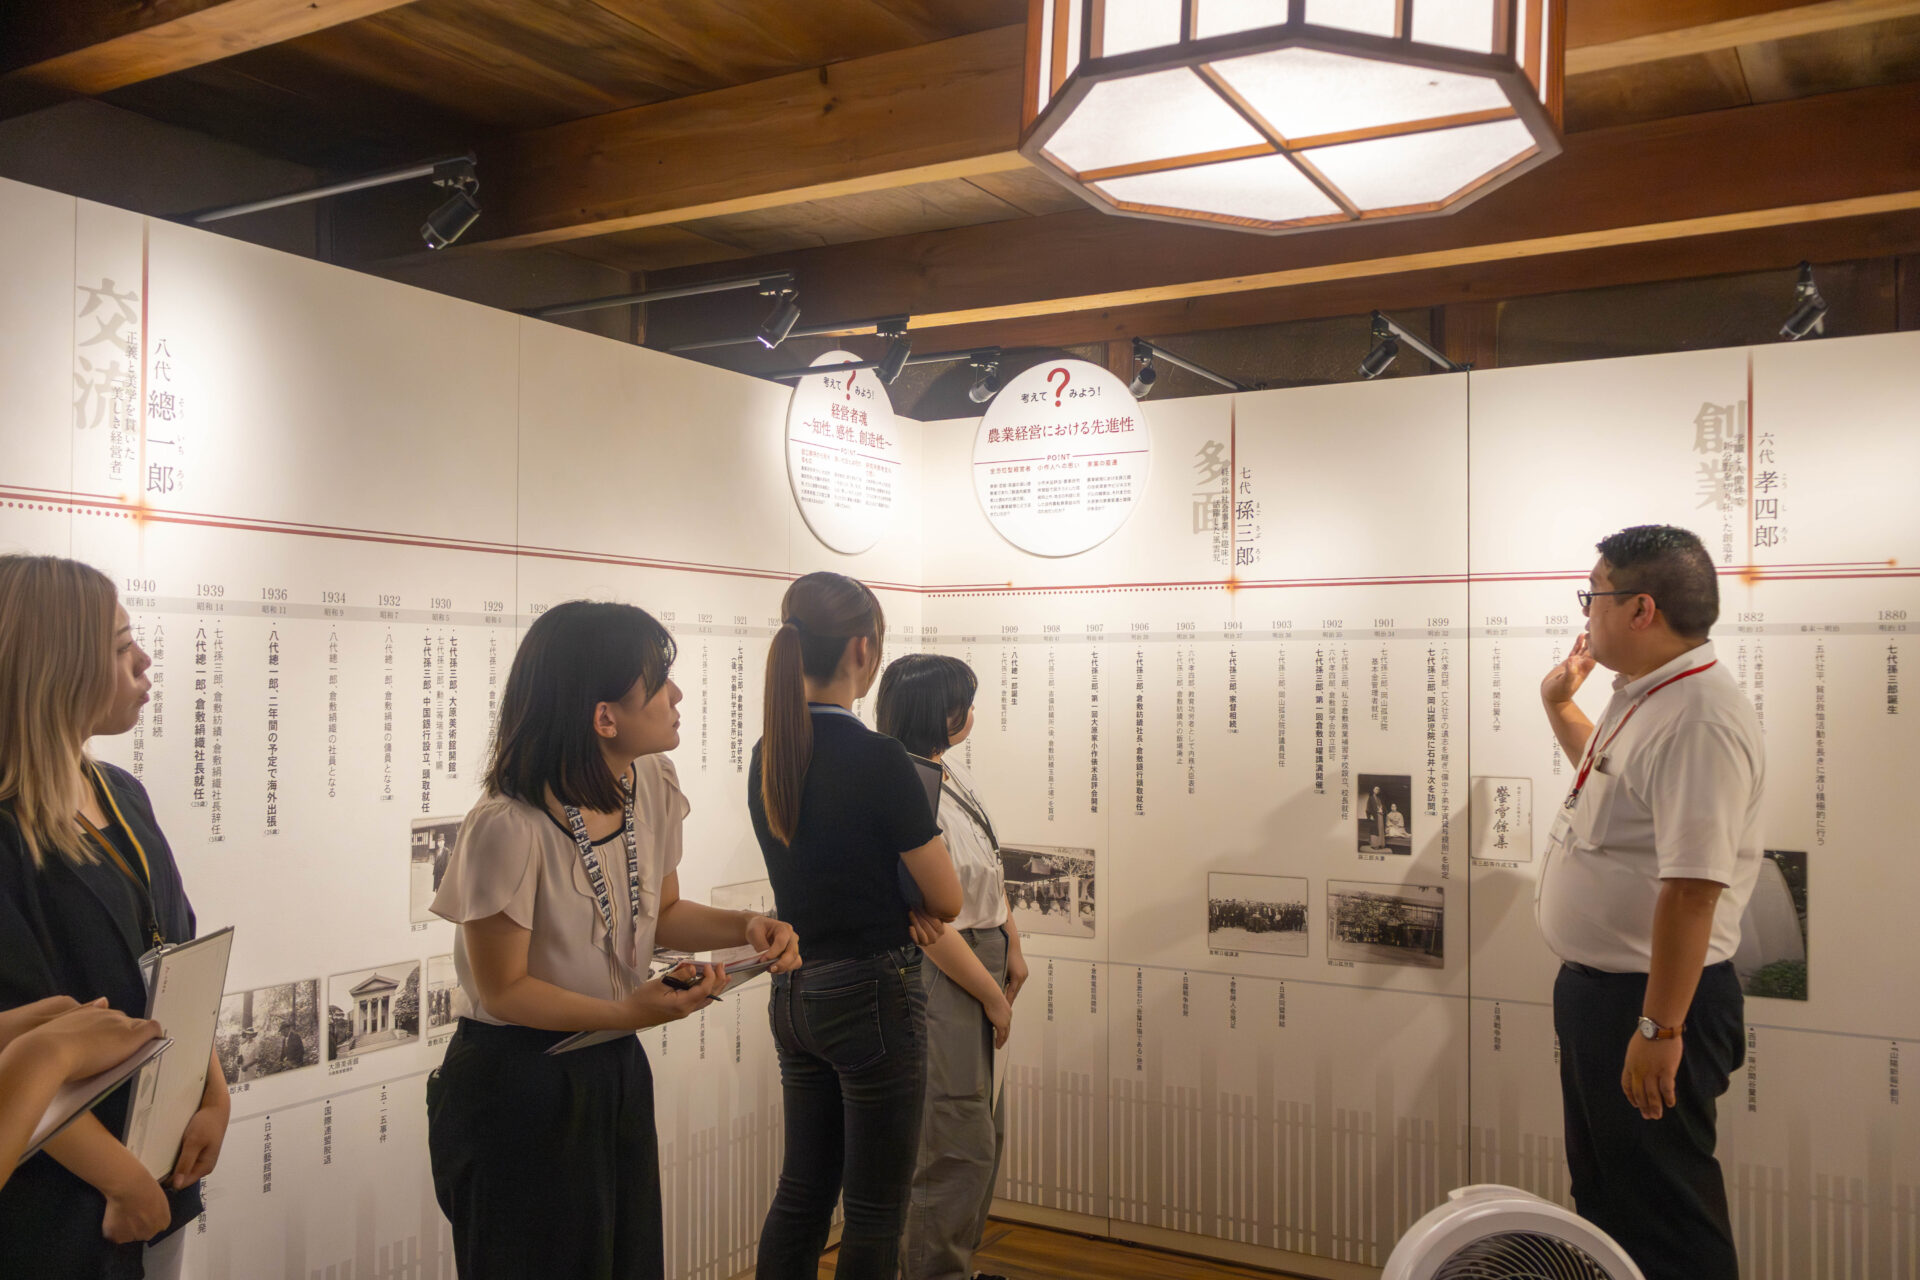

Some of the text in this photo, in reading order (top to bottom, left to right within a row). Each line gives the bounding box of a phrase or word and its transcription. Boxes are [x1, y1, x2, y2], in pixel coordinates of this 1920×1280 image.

[824, 376, 841, 391] 考えて
[1021, 392, 1047, 404] 考えて
[1047, 367, 1070, 407] ?
[987, 416, 1134, 443] 農業経営における先進性
[1235, 467, 1254, 566] 七代孫三郎
[126, 578, 156, 592] 1940
[197, 584, 224, 597] 1939
[261, 588, 288, 600] 1936
[321, 591, 346, 603] 1934
[378, 595, 400, 606] 1932
[430, 598, 451, 609] 1930
[483, 601, 503, 612] 1929
[698, 614, 712, 623] 1922
[1545, 615, 1568, 625] 1893
[1737, 612, 1764, 622] 1882
[1878, 610, 1907, 620] 1880
[734, 616, 747, 625] 1921
[1224, 621, 1242, 630] 1904
[1272, 620, 1292, 629] 1903
[1322, 619, 1343, 628] 1902
[1374, 618, 1394, 627] 1901
[1427, 617, 1449, 627] 1899
[1485, 616, 1508, 626] 1894
[921, 626, 937, 634] 1910
[1001, 625, 1018, 634] 1909
[1043, 624, 1060, 632] 1908
[1086, 624, 1104, 632] 1907
[1131, 622, 1149, 631] 1906
[1176, 622, 1195, 630] 1905
